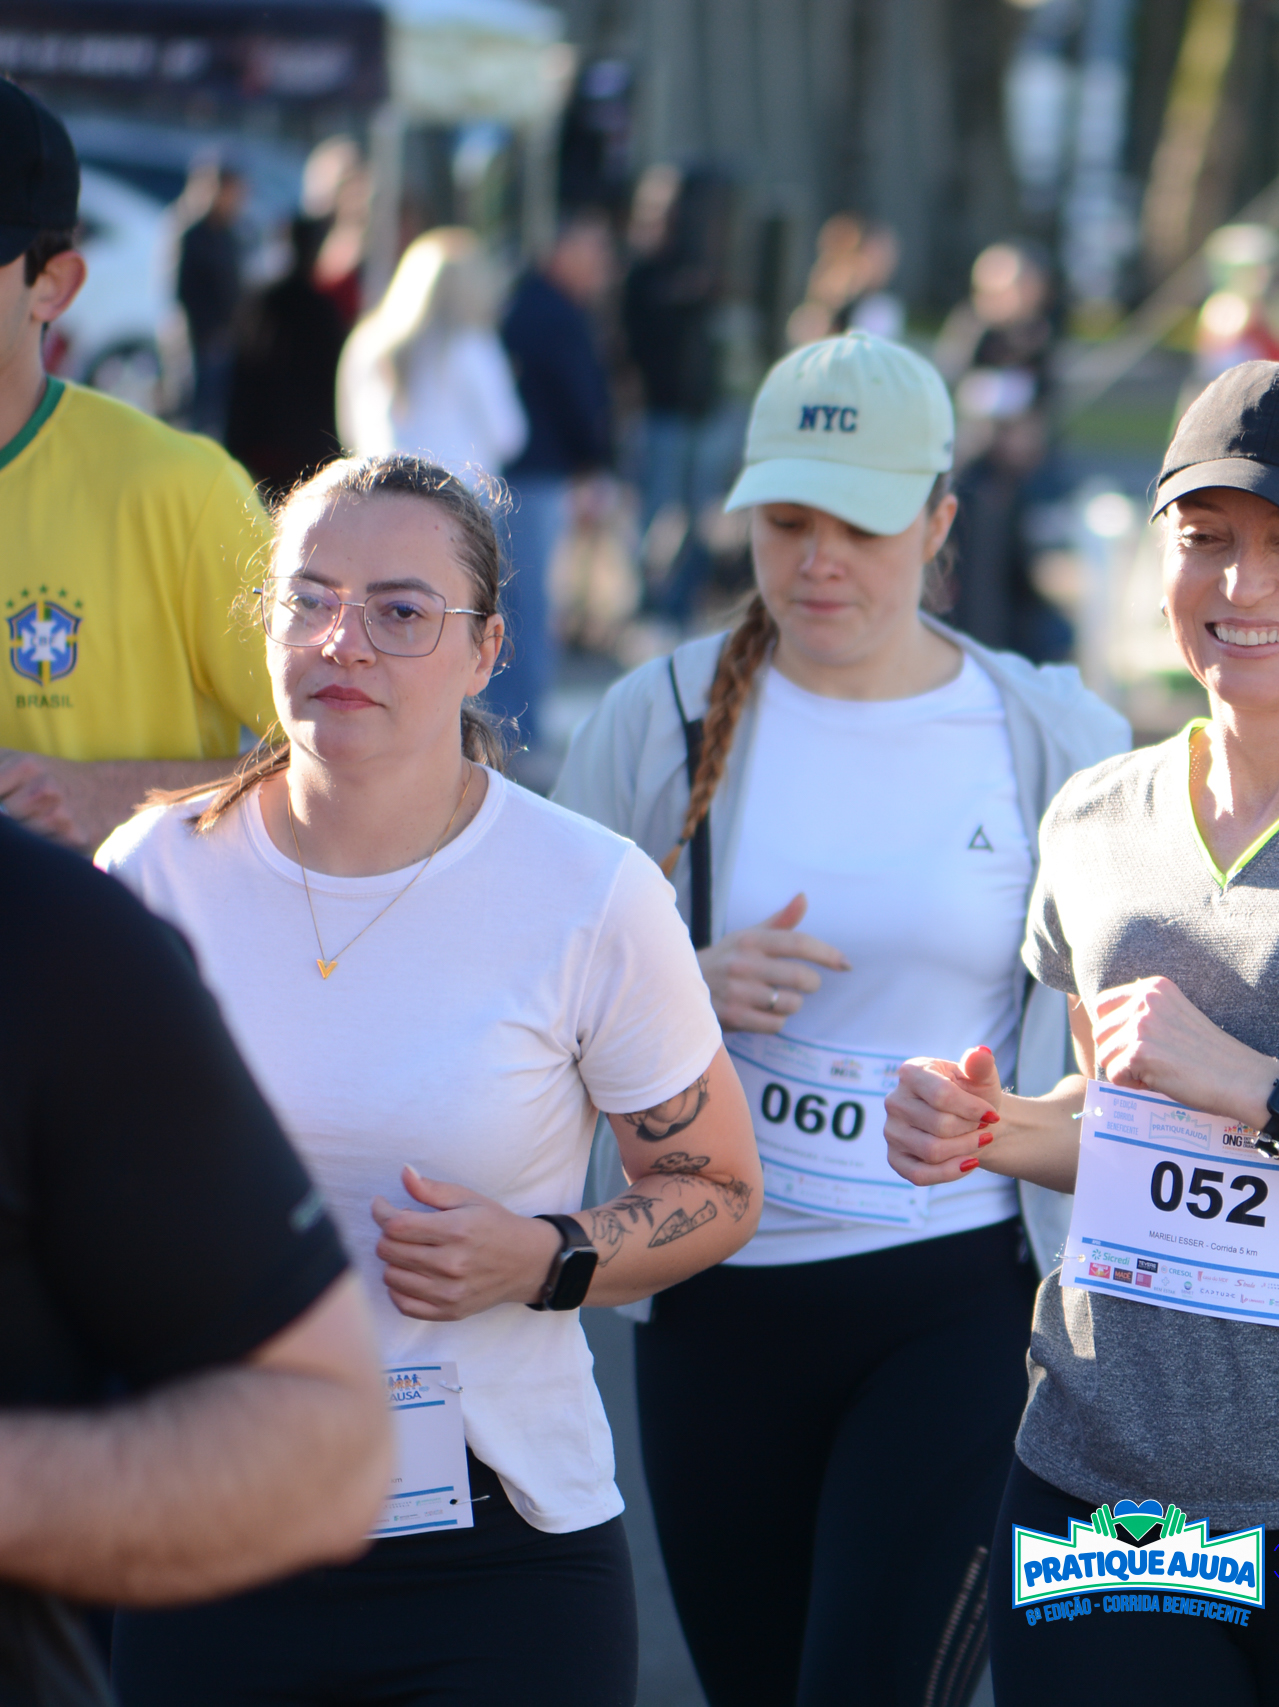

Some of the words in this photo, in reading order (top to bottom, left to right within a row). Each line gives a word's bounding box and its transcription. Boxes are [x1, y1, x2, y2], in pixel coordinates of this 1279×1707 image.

[799, 404, 858, 432] NYC
[16, 694, 73, 708] BRASIL
[761, 1082, 866, 1141] 060
[1113, 1110, 1135, 1122] CORRIDA
[1107, 1121, 1139, 1135] BENEFICENTE
[1222, 1133, 1243, 1147] ONG
[1151, 1160, 1268, 1227] 052
[1149, 1230, 1177, 1243] MARIELI
[1178, 1237, 1204, 1248] ESSER
[1210, 1242, 1238, 1254] Corrida
[1239, 1247, 1245, 1255] 5
[1246, 1248, 1258, 1256] km
[1103, 1252, 1130, 1266] Sicredi
[1168, 1267, 1193, 1278] CRESOL
[384, 1390, 422, 1402] AUSA
